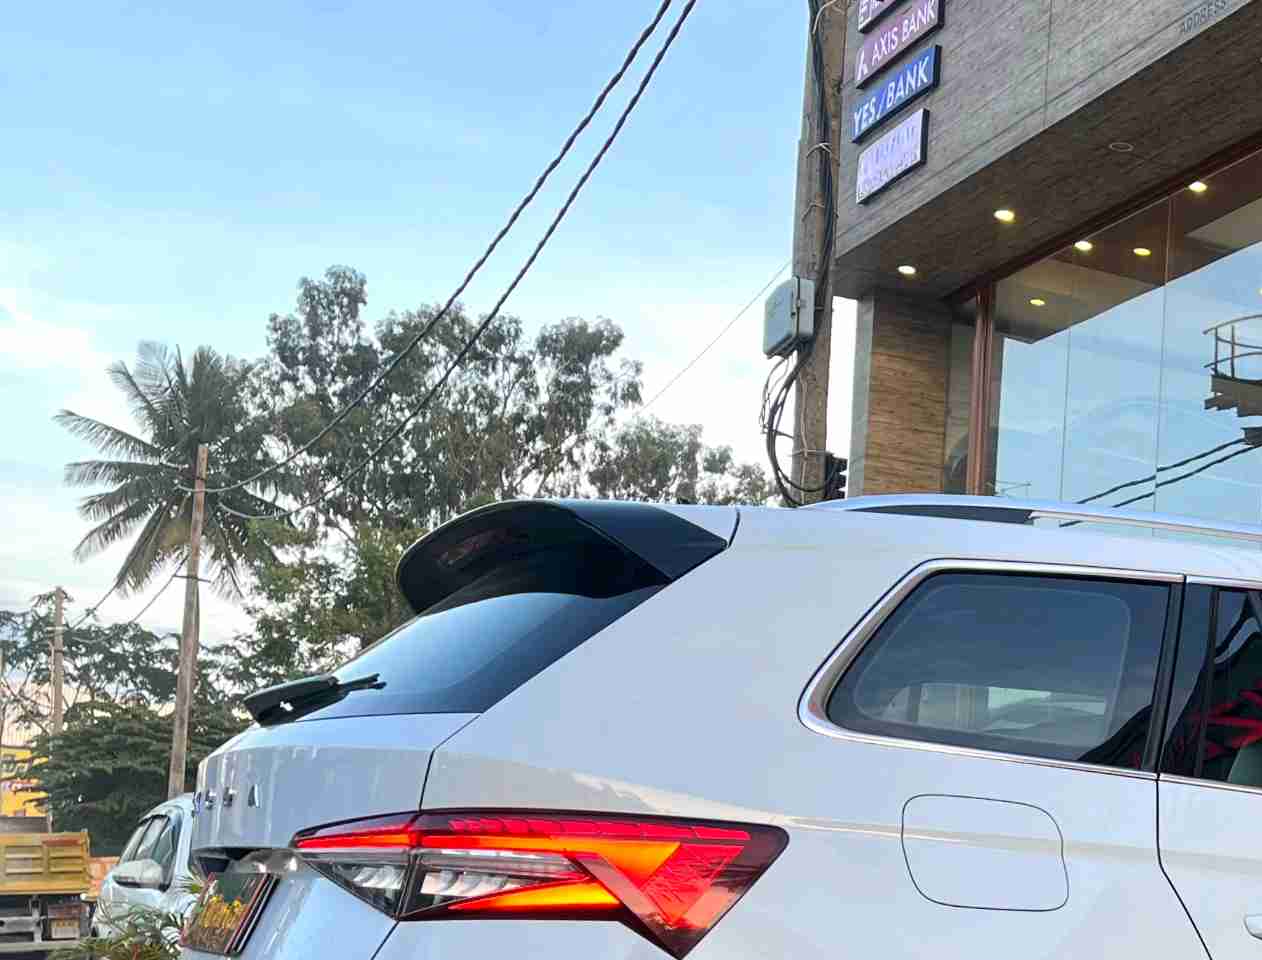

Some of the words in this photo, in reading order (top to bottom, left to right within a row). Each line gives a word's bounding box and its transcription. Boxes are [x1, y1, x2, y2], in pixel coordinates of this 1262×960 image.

[871, 26, 899, 66] AXIS
[901, 0, 935, 42] BANK
[886, 55, 930, 110] BANK
